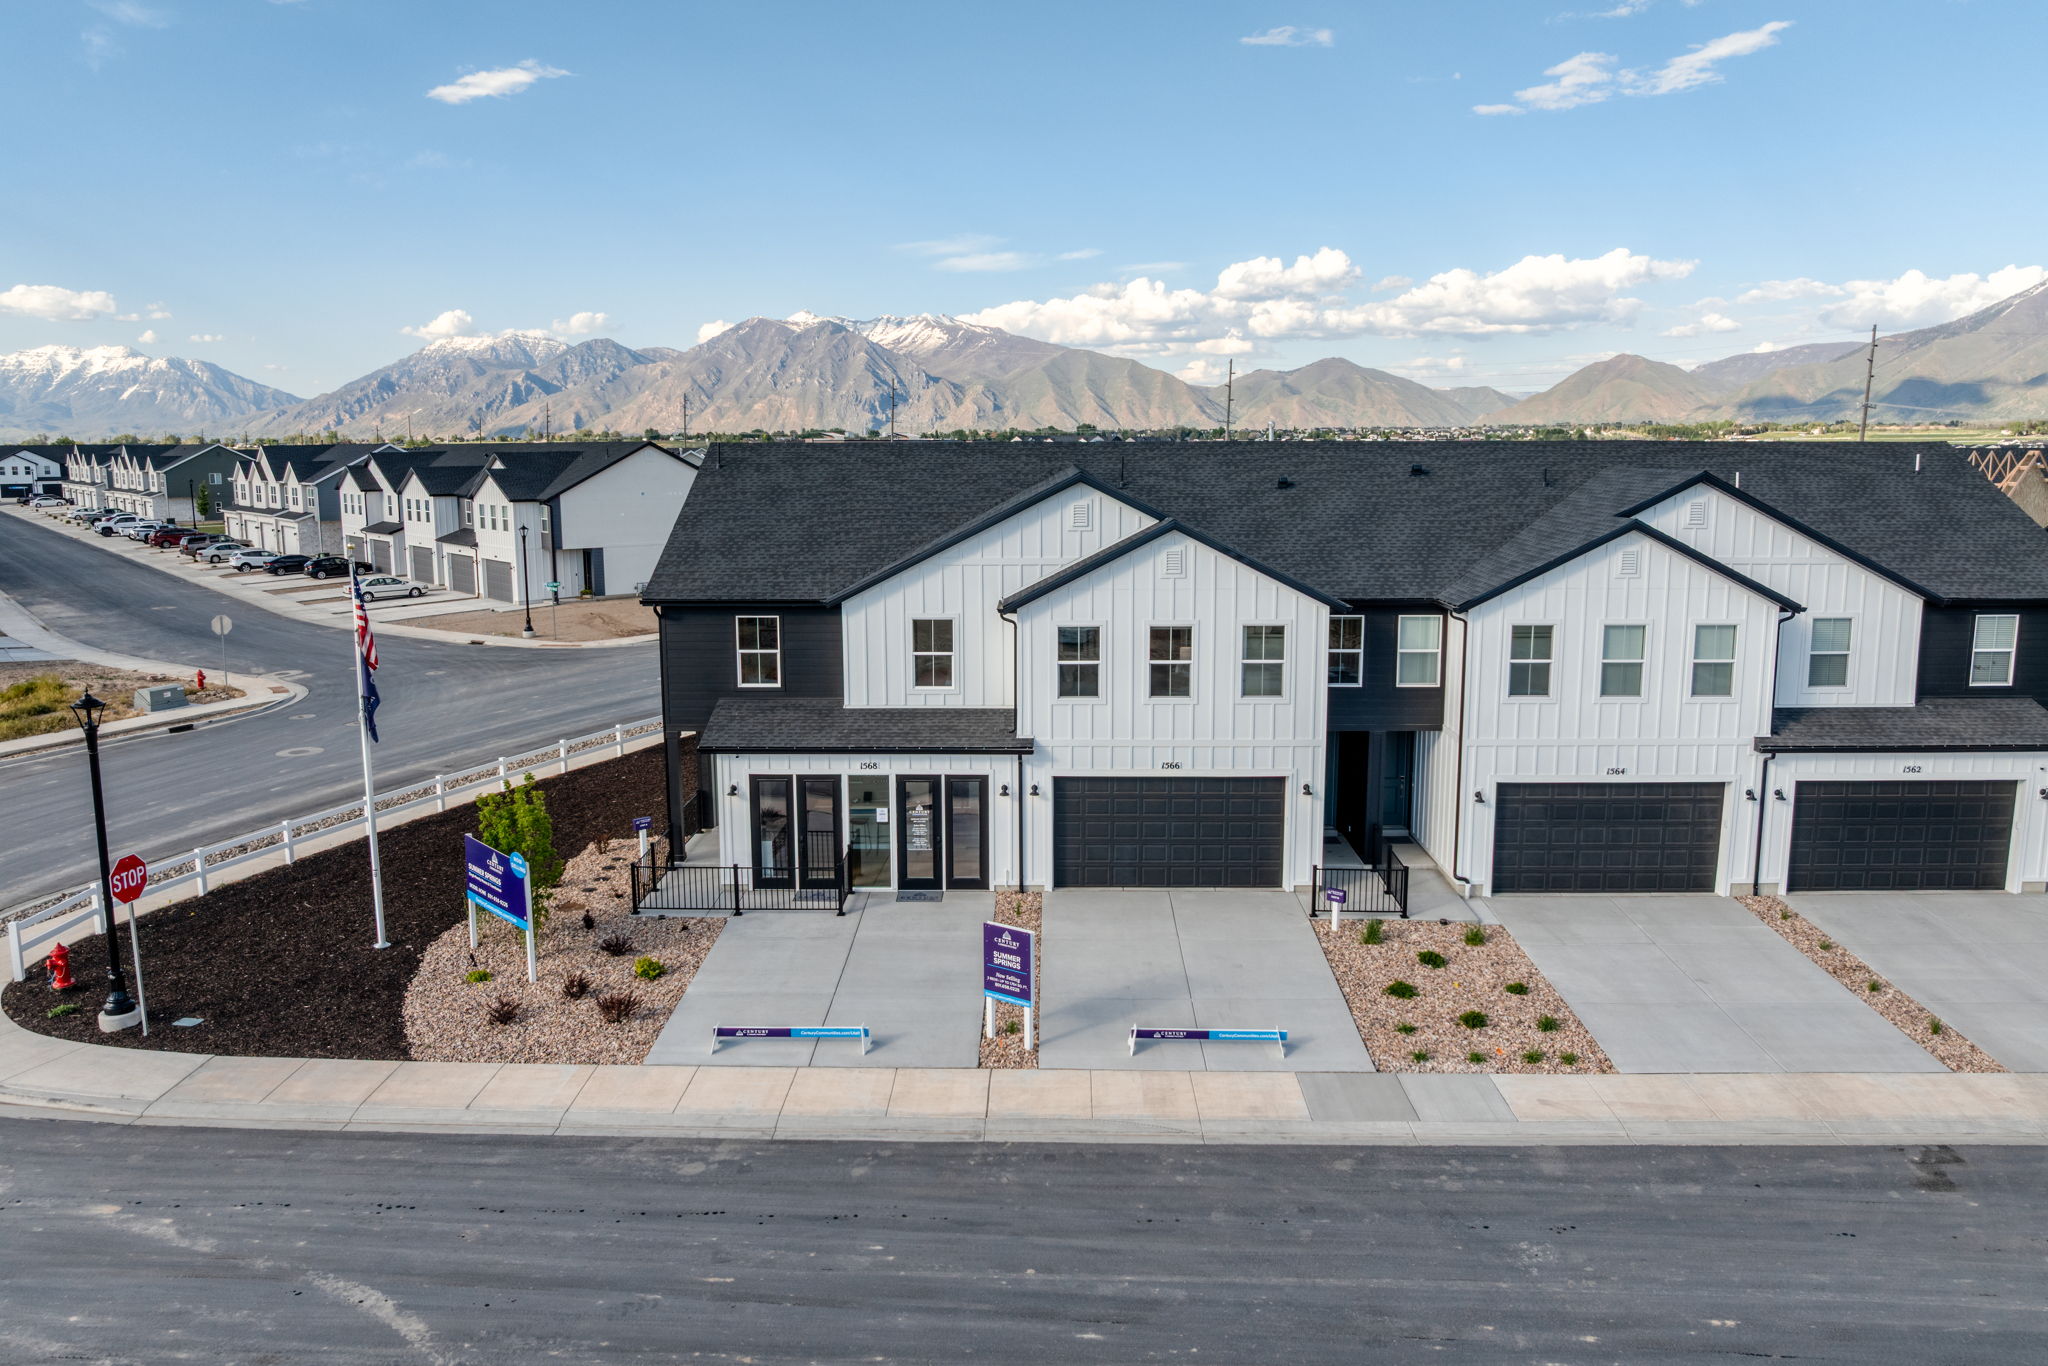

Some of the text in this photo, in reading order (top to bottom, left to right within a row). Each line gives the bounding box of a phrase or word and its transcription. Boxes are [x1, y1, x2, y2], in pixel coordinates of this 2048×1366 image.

[860, 762, 878, 770] 1568
[1161, 762, 1180, 770] 1566
[1903, 765, 1922, 774] 1562
[1606, 767, 1625, 775] 1564
[113, 865, 145, 893] STOP
[994, 937, 1020, 947] CENTURY
[993, 950, 1021, 963] SUMMER
[993, 958, 1021, 970] SPRINGS
